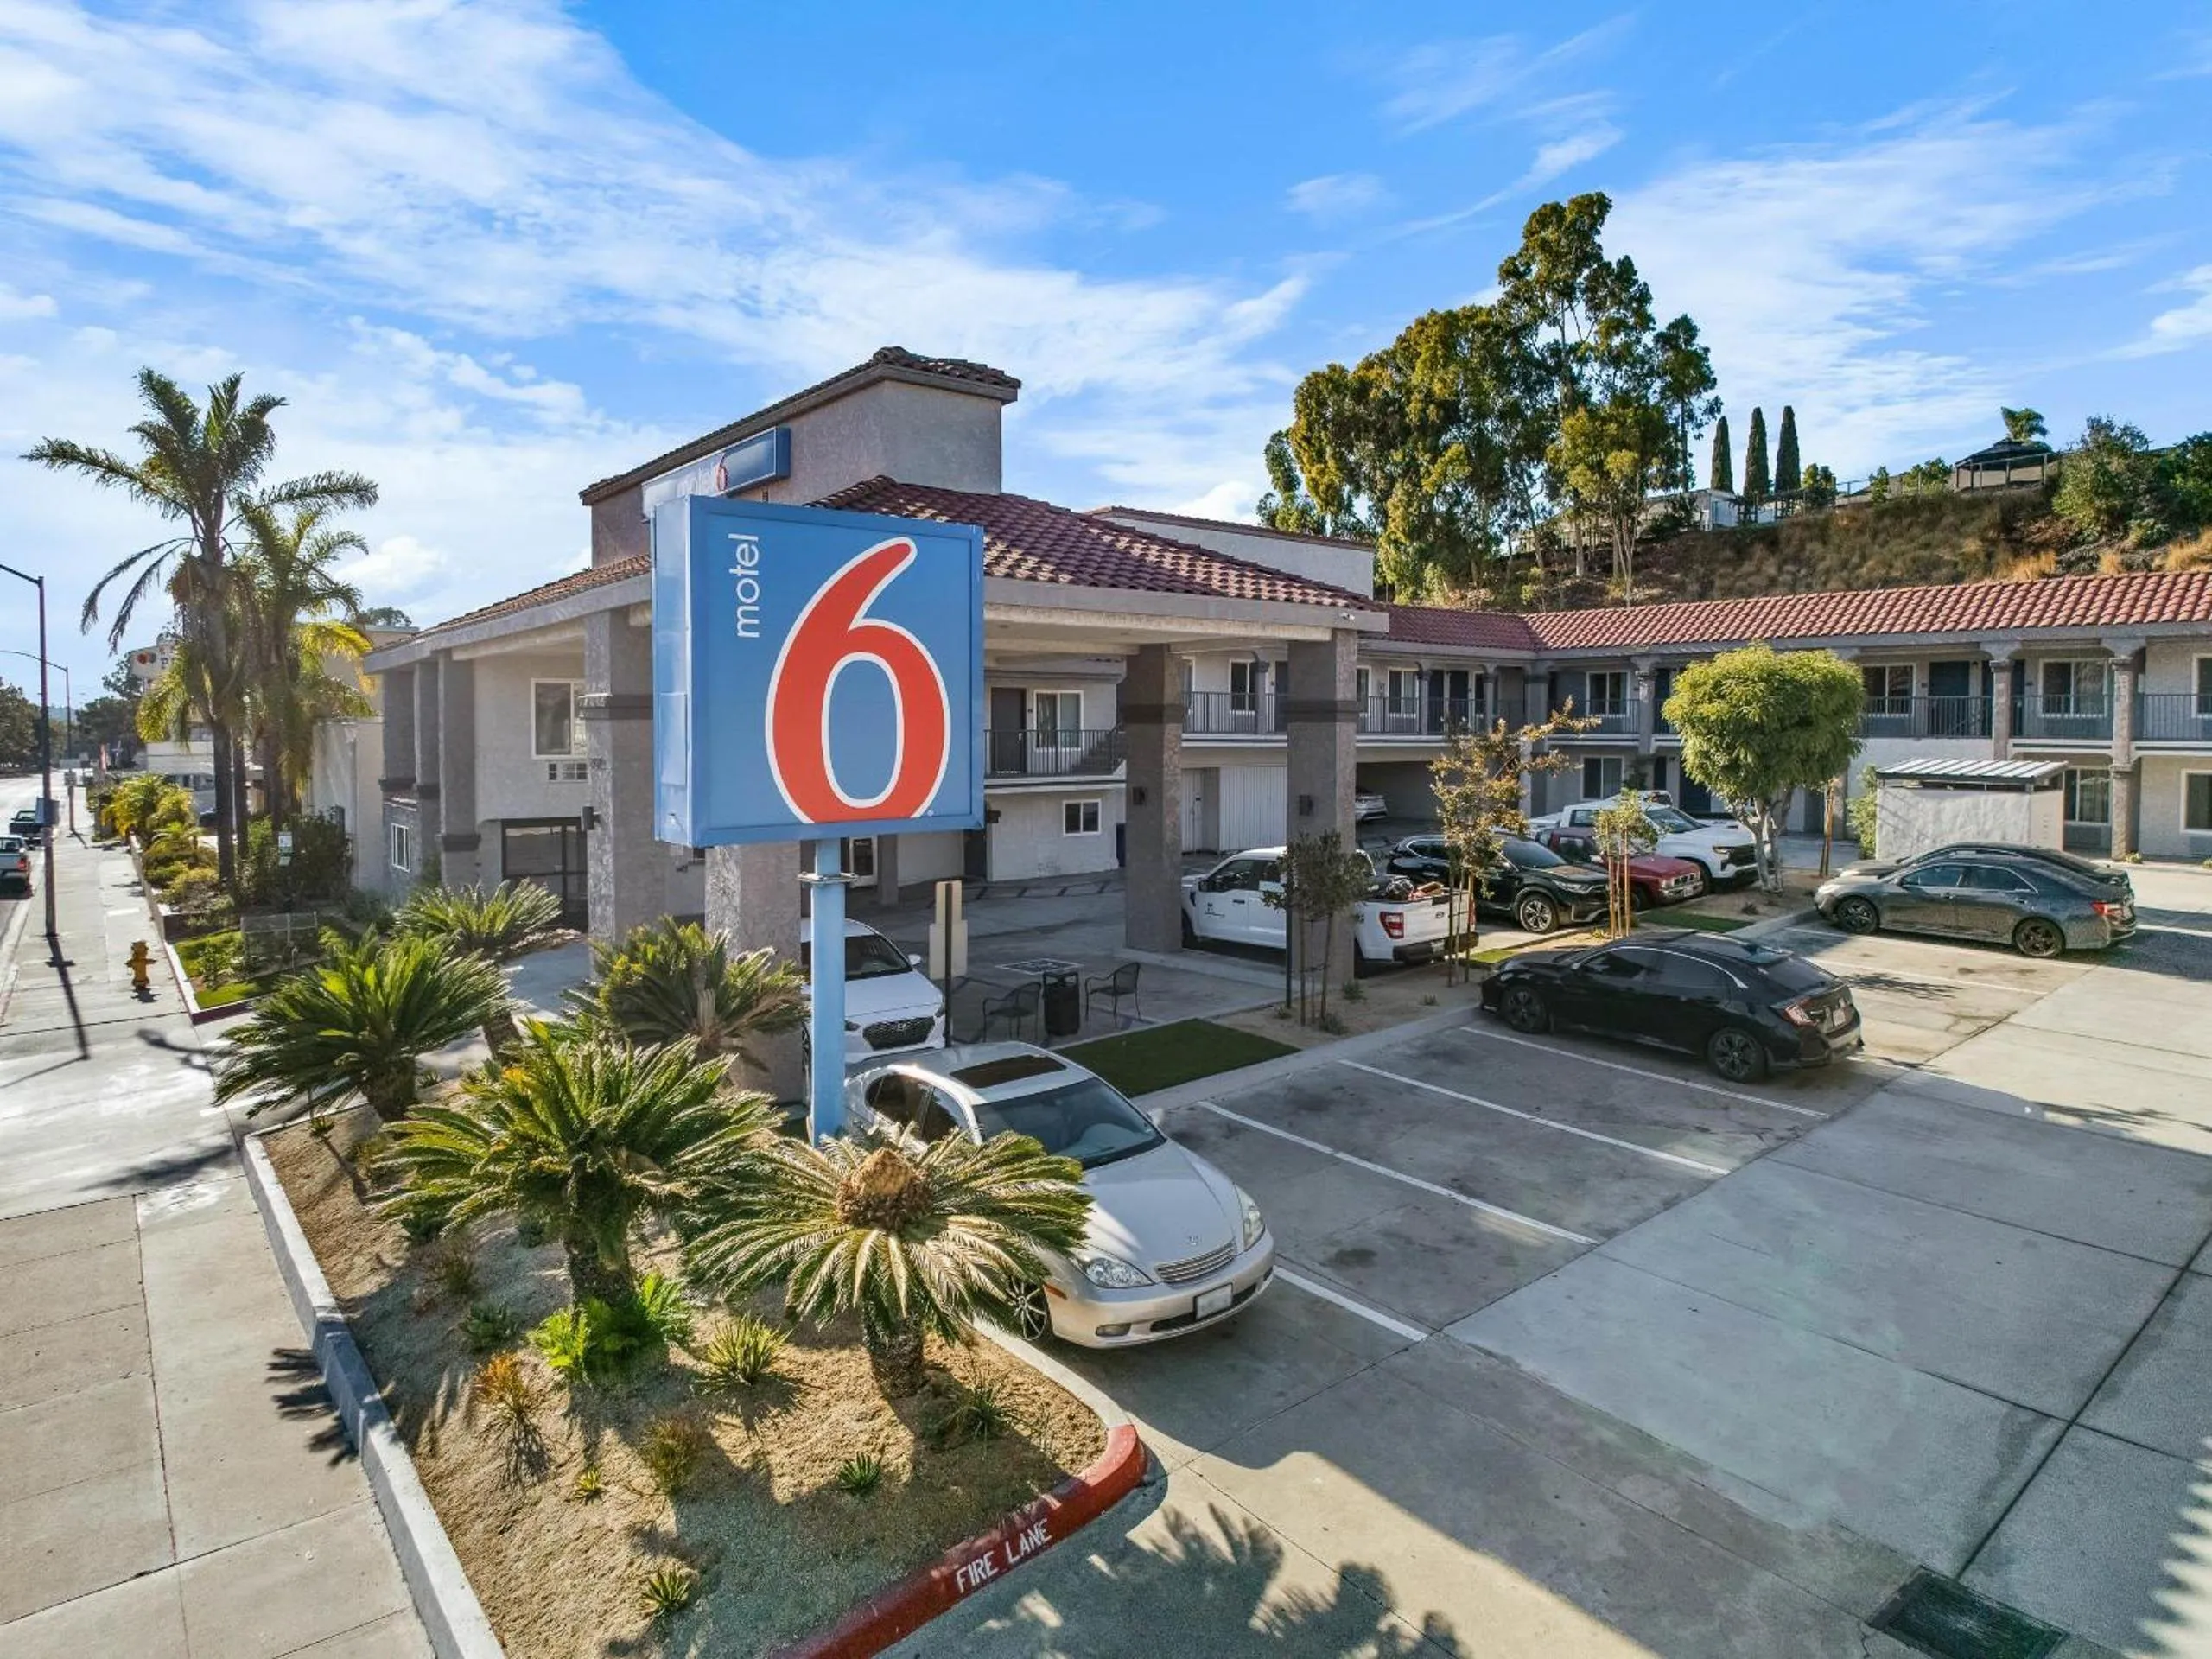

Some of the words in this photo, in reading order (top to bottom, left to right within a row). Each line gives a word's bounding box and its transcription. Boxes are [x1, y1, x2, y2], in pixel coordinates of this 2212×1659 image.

[715, 452, 728, 492] 6
[728, 533, 760, 638] motel
[765, 537, 950, 823] 6
[957, 1550, 999, 1593] FIRE
[1005, 1518, 1052, 1564] LANE
